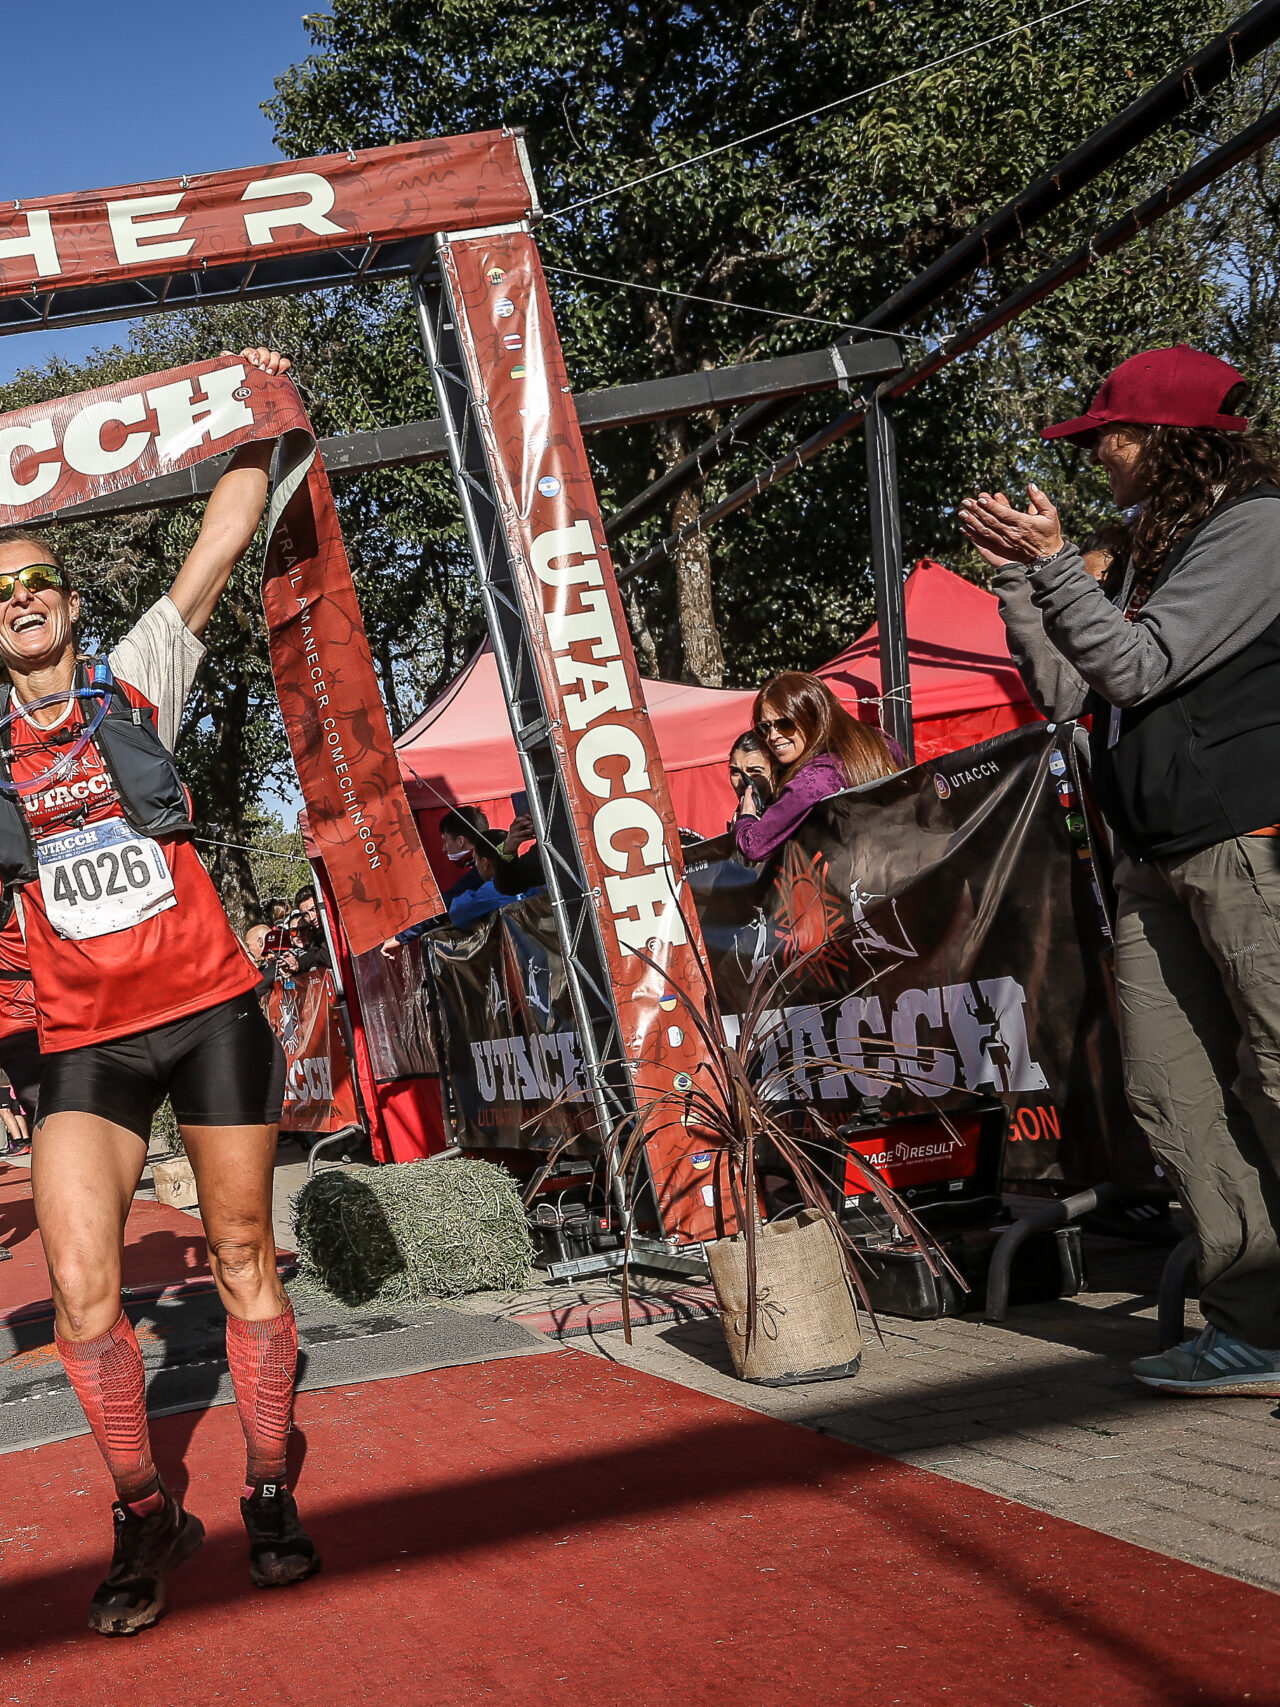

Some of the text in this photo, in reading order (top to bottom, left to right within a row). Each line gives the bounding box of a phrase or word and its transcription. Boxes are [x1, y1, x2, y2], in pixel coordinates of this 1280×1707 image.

[276, 523, 382, 871] TRAIL AMANECER COMECHINGON
[528, 518, 688, 958] UTACCH
[949, 760, 1001, 790] UTACCH
[53, 845, 151, 907] 4026
[910, 1141, 956, 1159] RESULT
